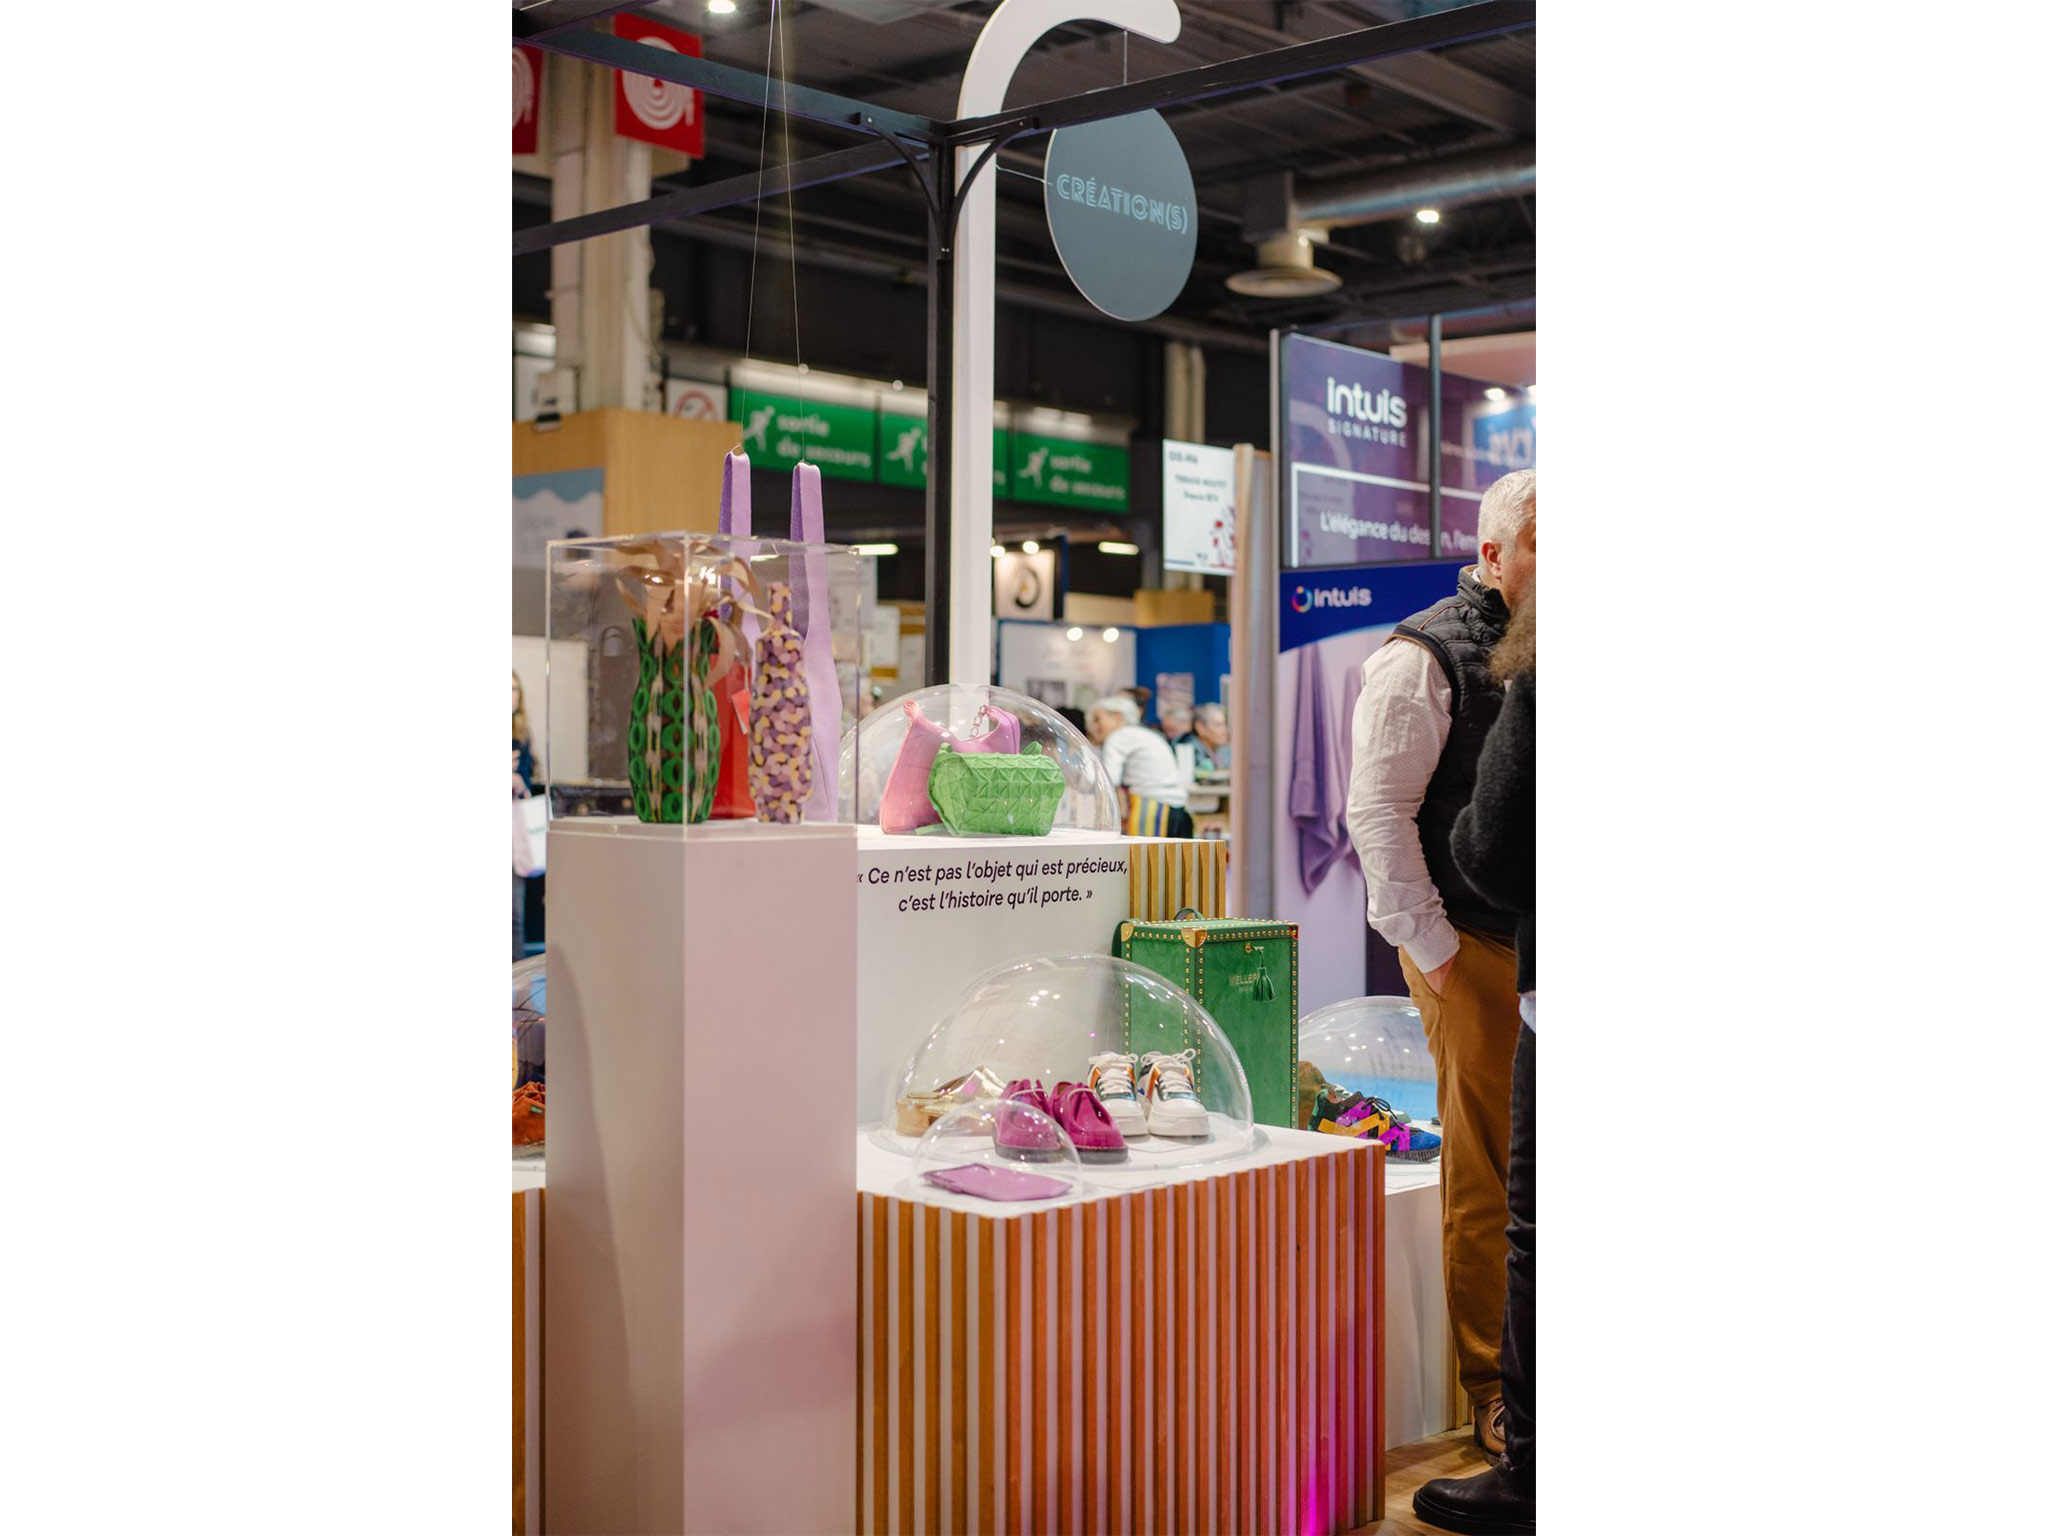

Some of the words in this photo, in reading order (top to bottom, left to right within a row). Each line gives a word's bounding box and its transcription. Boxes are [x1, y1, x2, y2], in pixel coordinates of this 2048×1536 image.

[1056, 173, 1188, 235] CRÉATION(S)
[1326, 376, 1408, 428] intuis
[1327, 418, 1407, 448] SIGNATURE
[1313, 586, 1373, 608] intuis
[868, 867, 890, 884] Ce
[894, 865, 932, 883] n'est
[934, 867, 962, 886] pas
[966, 860, 1012, 883] l'objet
[1015, 859, 1039, 881] qui
[1041, 859, 1063, 875] est
[1065, 857, 1128, 879] précieux,
[898, 893, 936, 912] c'est
[939, 889, 1003, 910] l'histoire
[1007, 885, 1038, 910] qu'il
[1040, 886, 1082, 908] porte.
